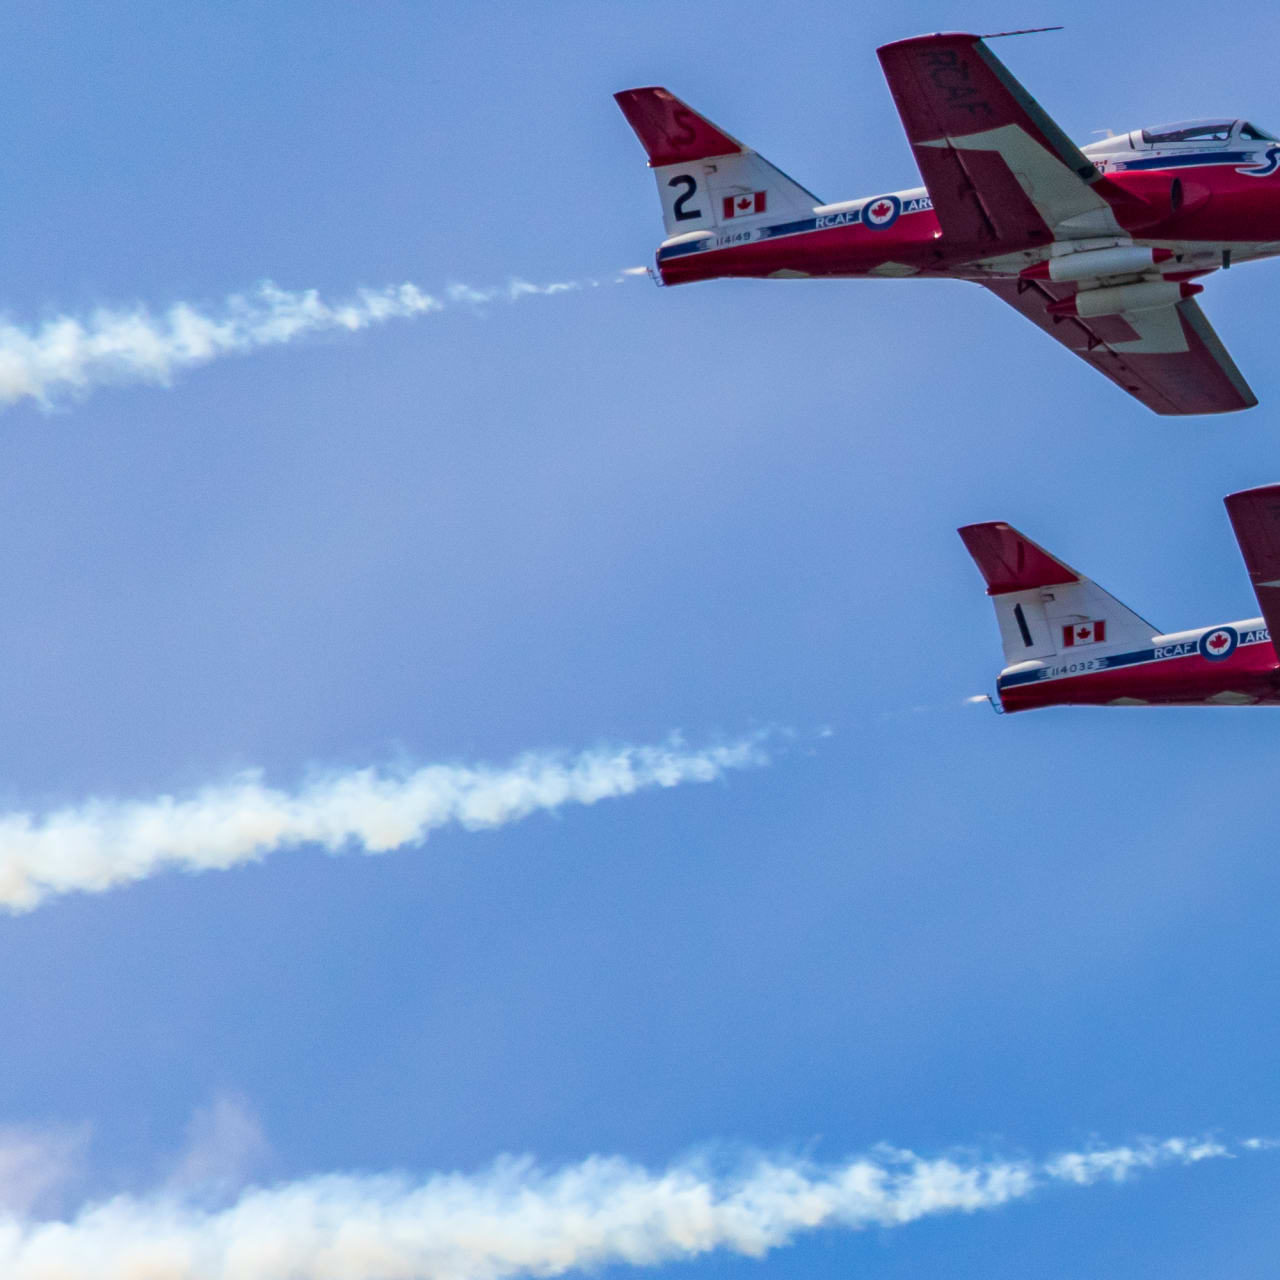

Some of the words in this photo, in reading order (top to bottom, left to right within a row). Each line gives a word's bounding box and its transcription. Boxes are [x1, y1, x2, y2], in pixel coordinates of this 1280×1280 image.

[918, 50, 995, 115] RCAF
[668, 174, 702, 221] 2
[815, 211, 854, 228] RCAF
[1013, 602, 1034, 647] 1
[1154, 642, 1192, 659] RCAF
[1051, 661, 1094, 676] 114032
